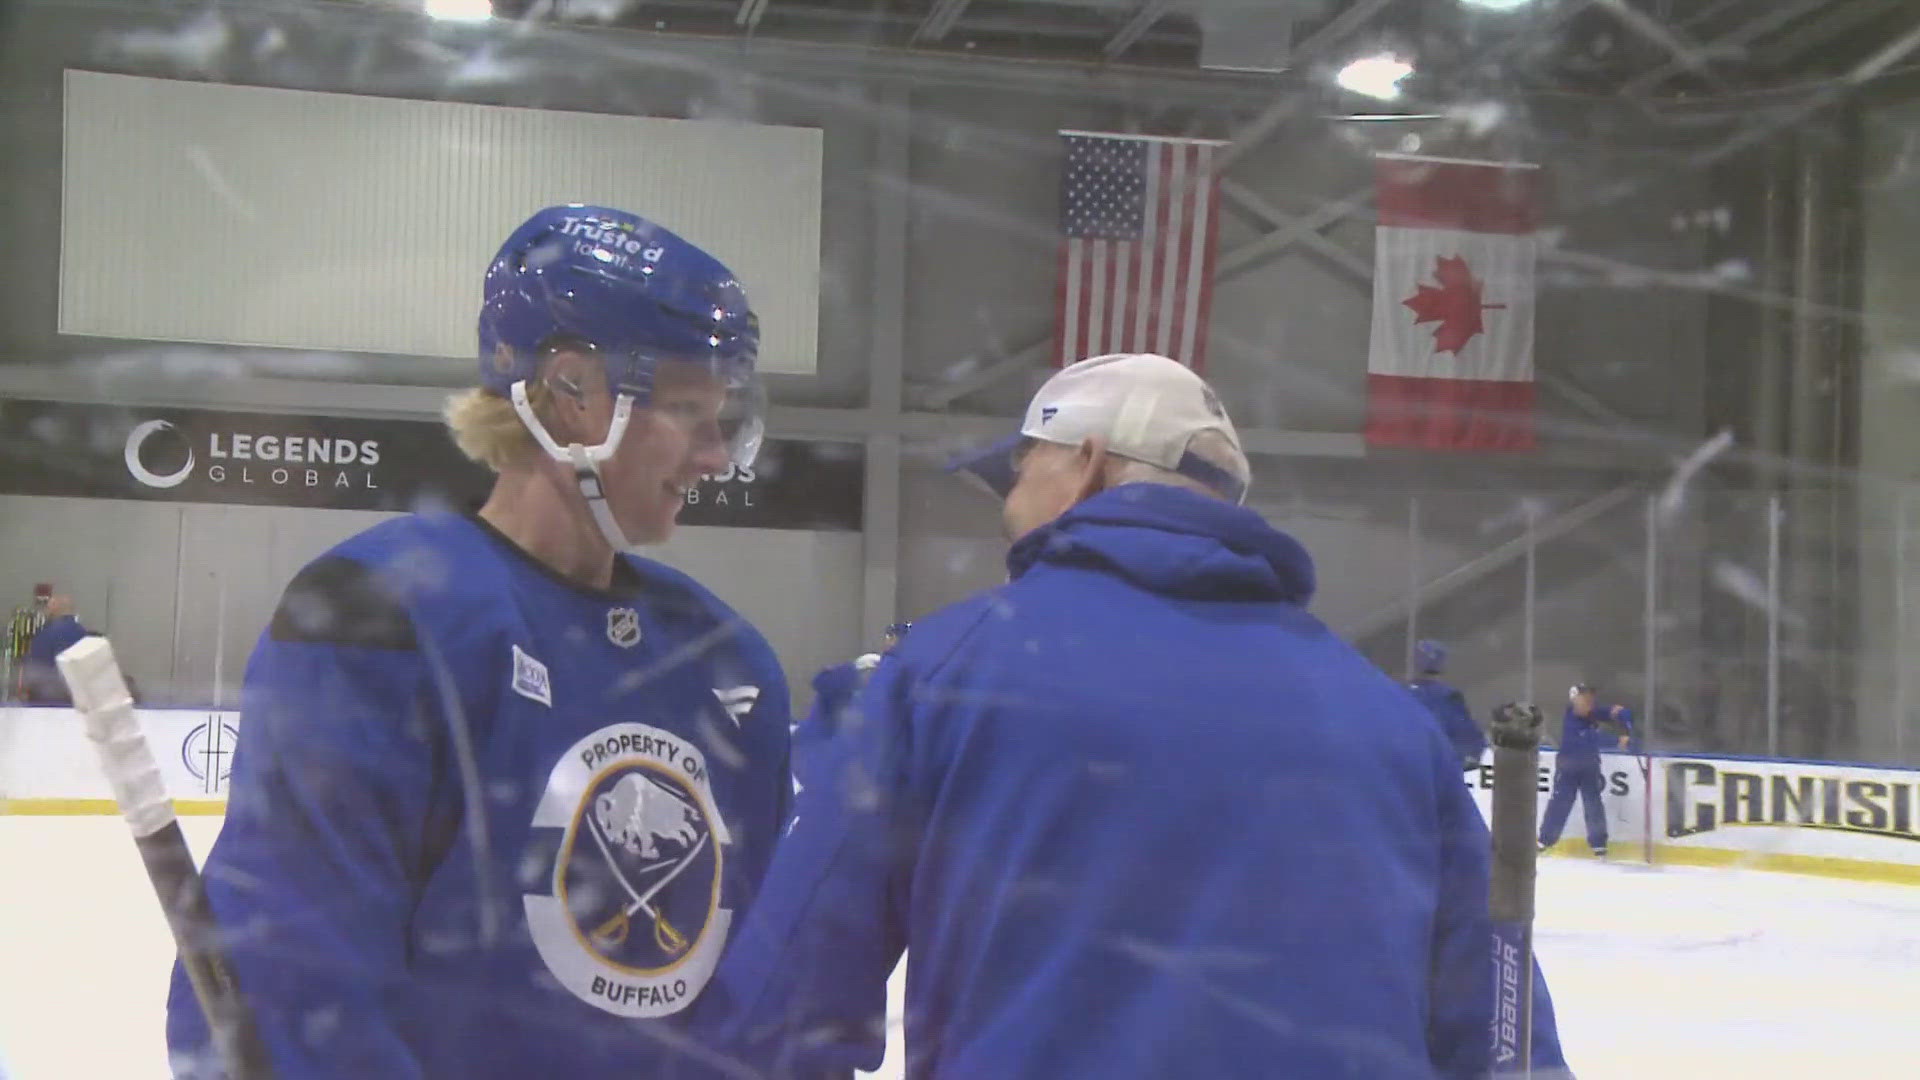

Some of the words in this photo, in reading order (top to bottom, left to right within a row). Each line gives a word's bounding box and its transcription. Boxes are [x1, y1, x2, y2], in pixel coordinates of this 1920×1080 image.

[560, 217, 664, 262] Trusted
[210, 433, 380, 465] LEGENDS
[209, 465, 378, 489] GLOBAL
[581, 734, 679, 770] PROPERTY
[590, 975, 687, 1006] BUFFALO
[1500, 943, 1518, 1045] BAUER
